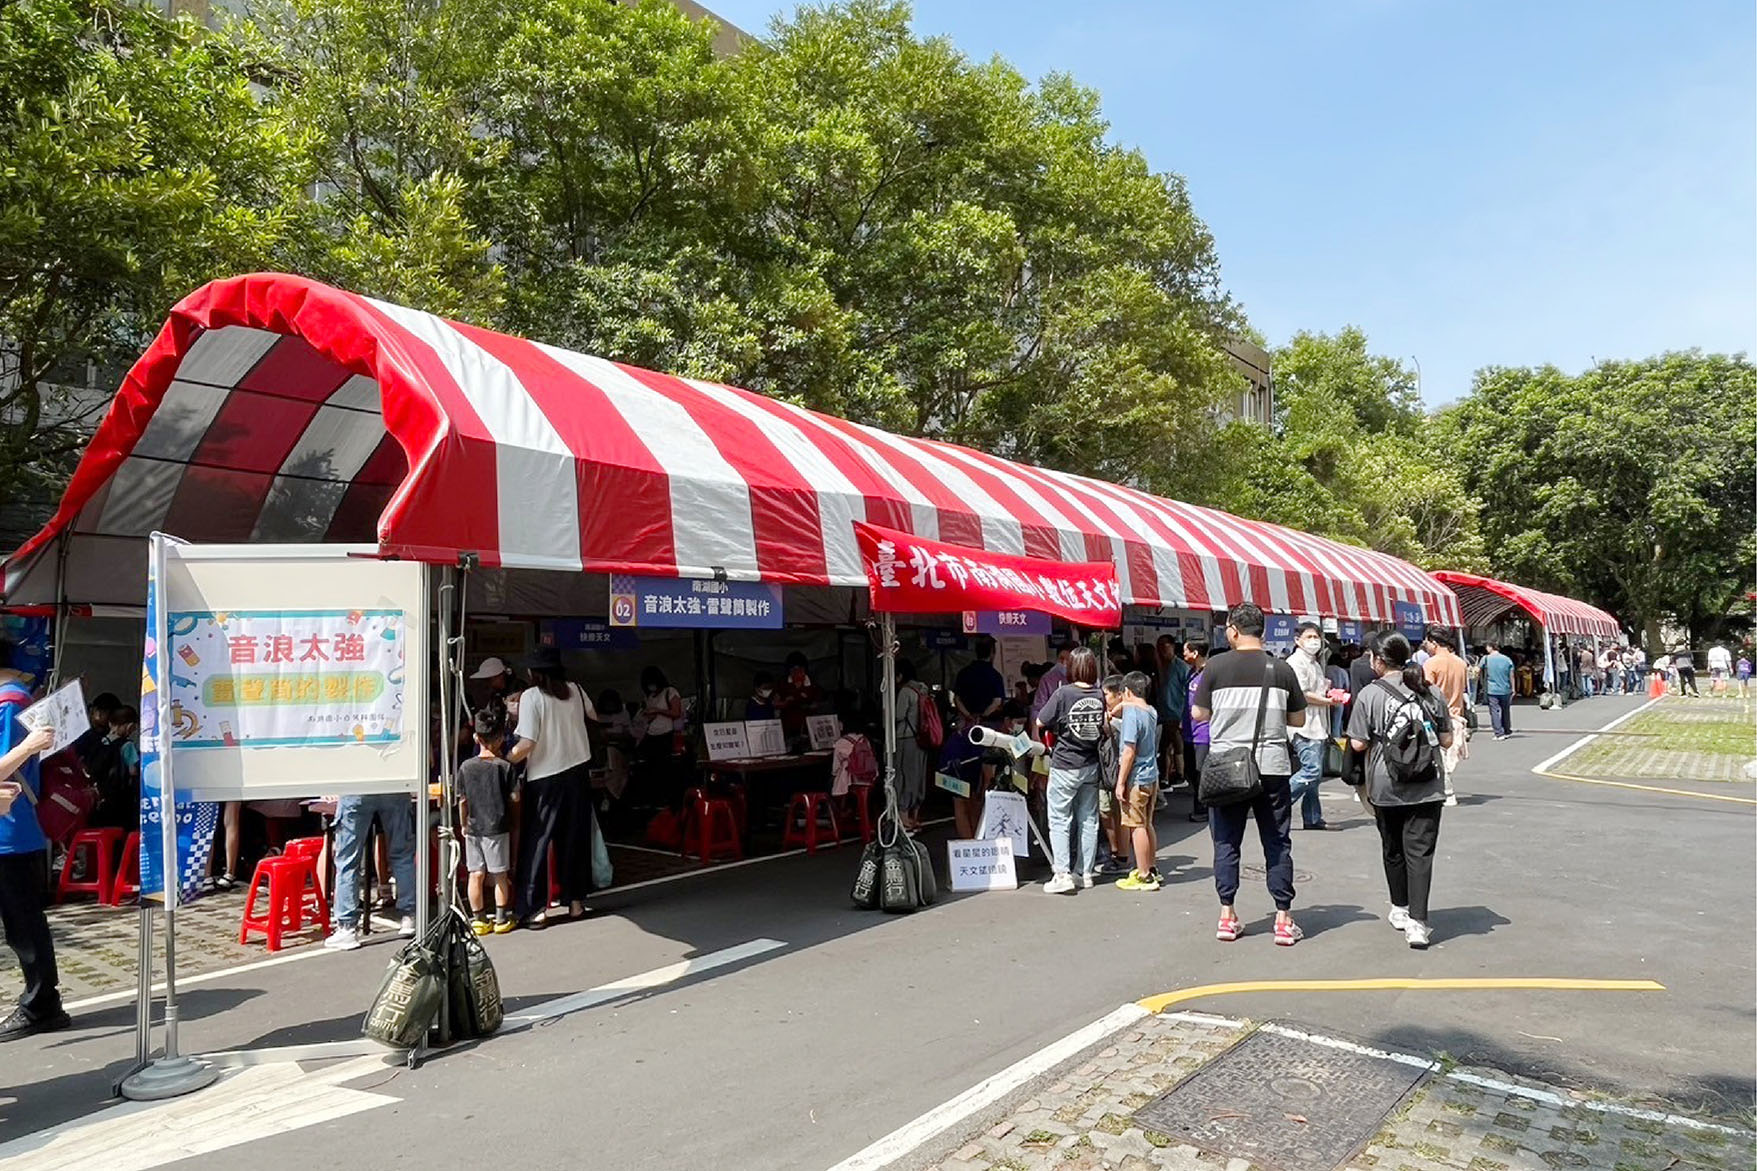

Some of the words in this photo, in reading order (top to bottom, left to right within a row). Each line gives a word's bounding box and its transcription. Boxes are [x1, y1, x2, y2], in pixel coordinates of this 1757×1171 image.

[692, 580, 728, 594] 南湖國小
[616, 605, 630, 617] 02
[644, 594, 770, 617] 音浪太強-雷聲筒製作
[228, 632, 366, 665] 音浪太強
[960, 864, 1007, 876] 天文望遠鏡
